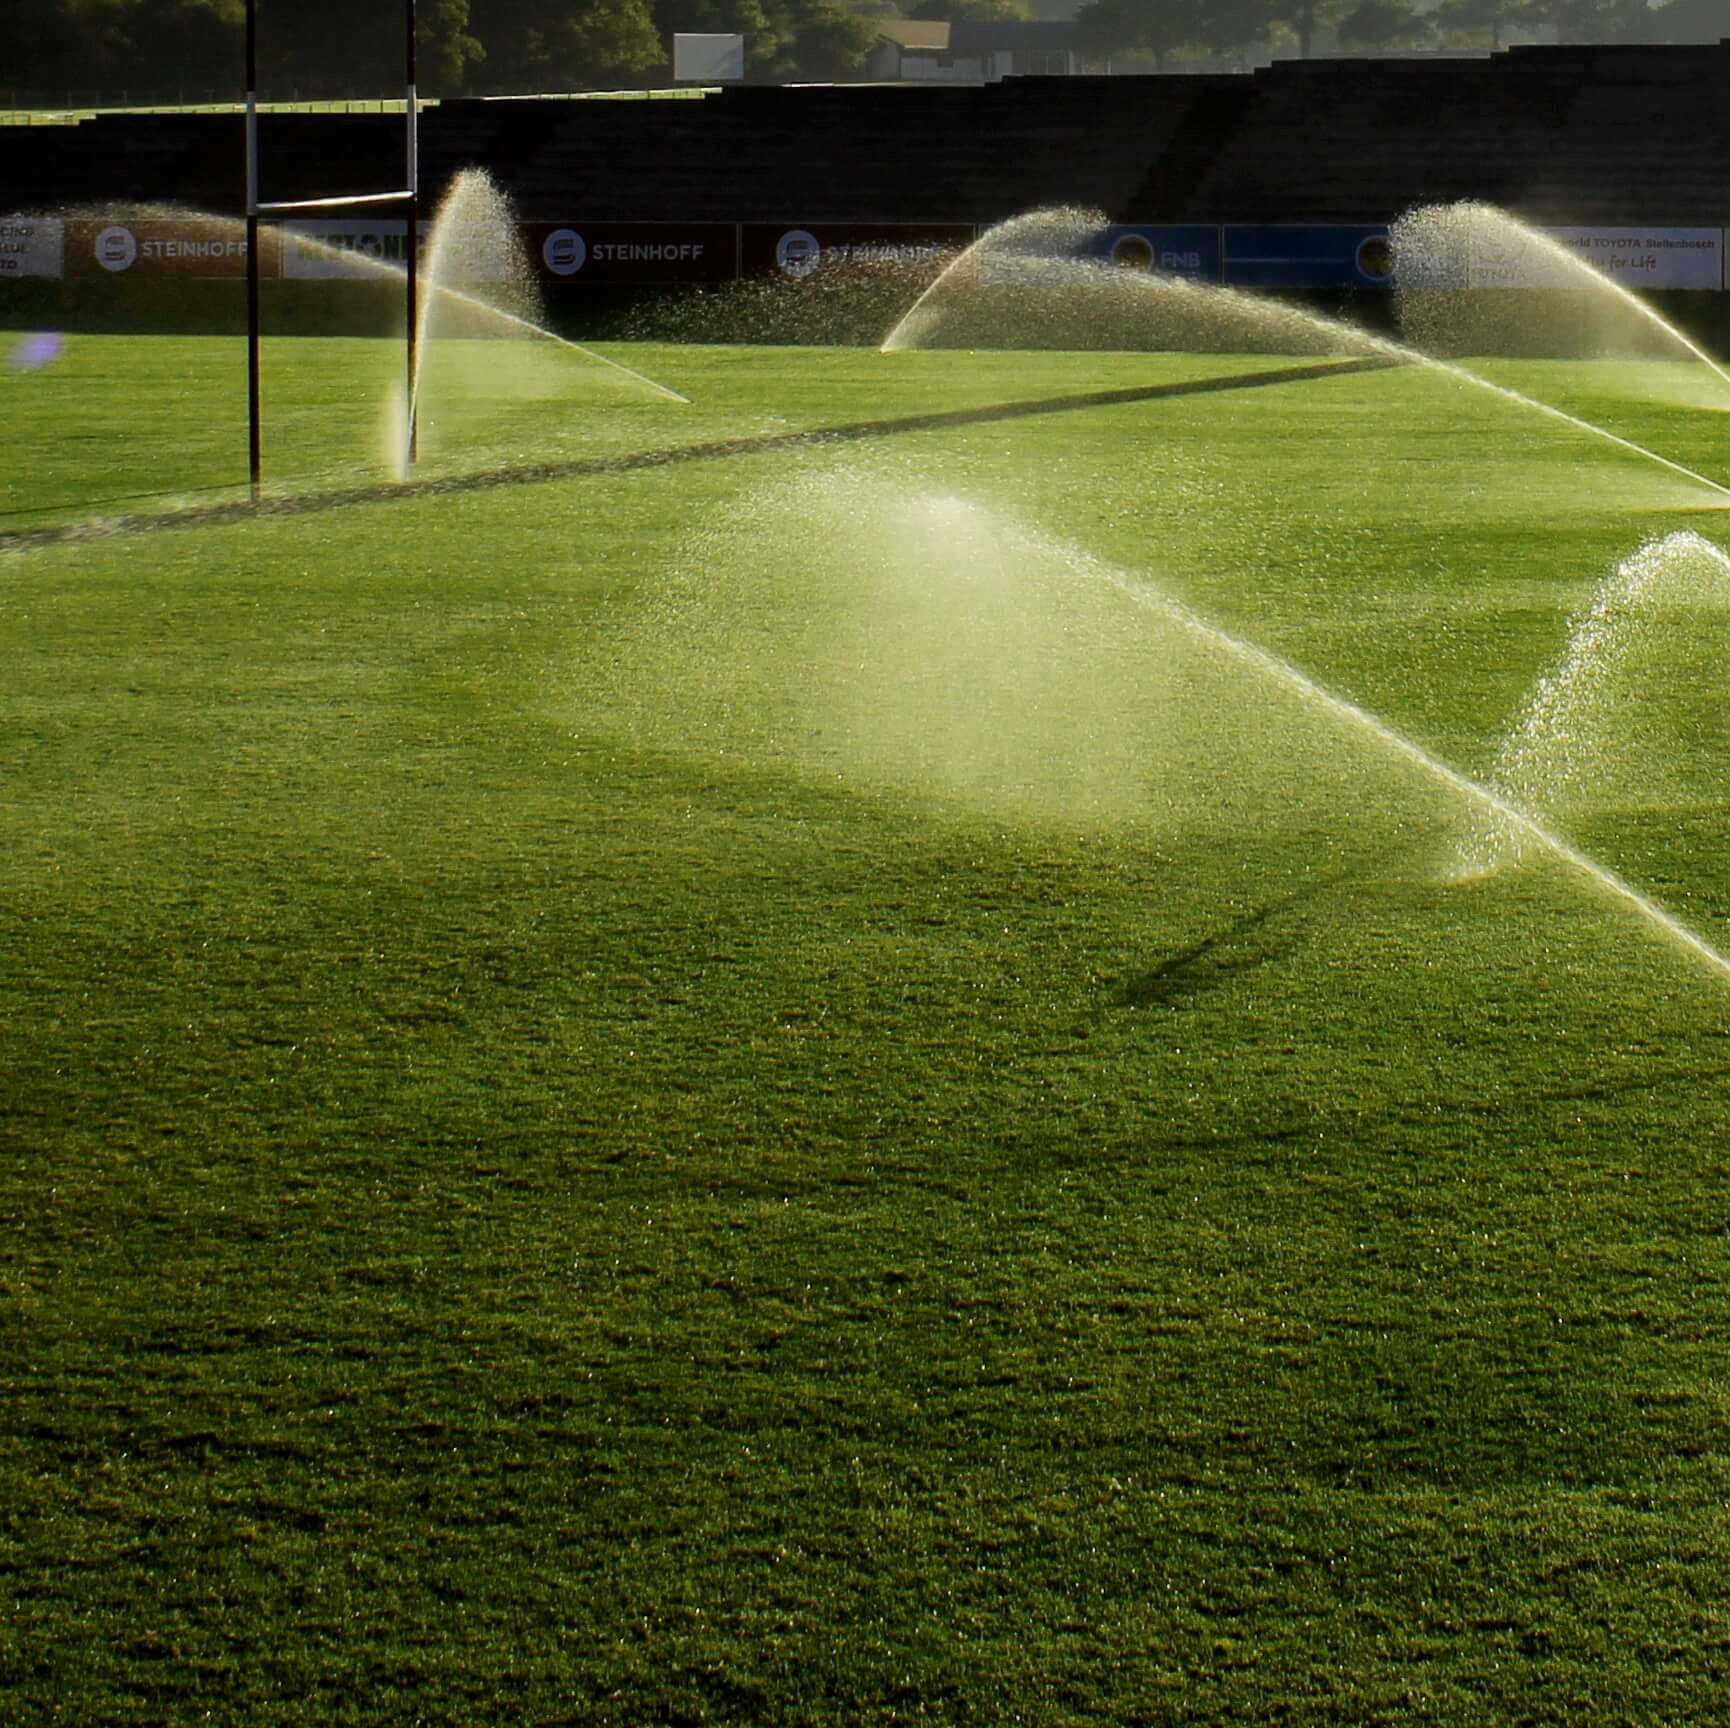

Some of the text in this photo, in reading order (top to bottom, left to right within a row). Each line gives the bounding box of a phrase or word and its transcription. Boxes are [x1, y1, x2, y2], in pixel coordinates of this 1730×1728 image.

[142, 240, 248, 257] STEINHOFF
[1594, 238, 1642, 250] TOYOTA
[1645, 238, 1715, 250] Stellenbosch
[592, 244, 704, 261] STEINHOFF
[1161, 252, 1200, 267] FNB
